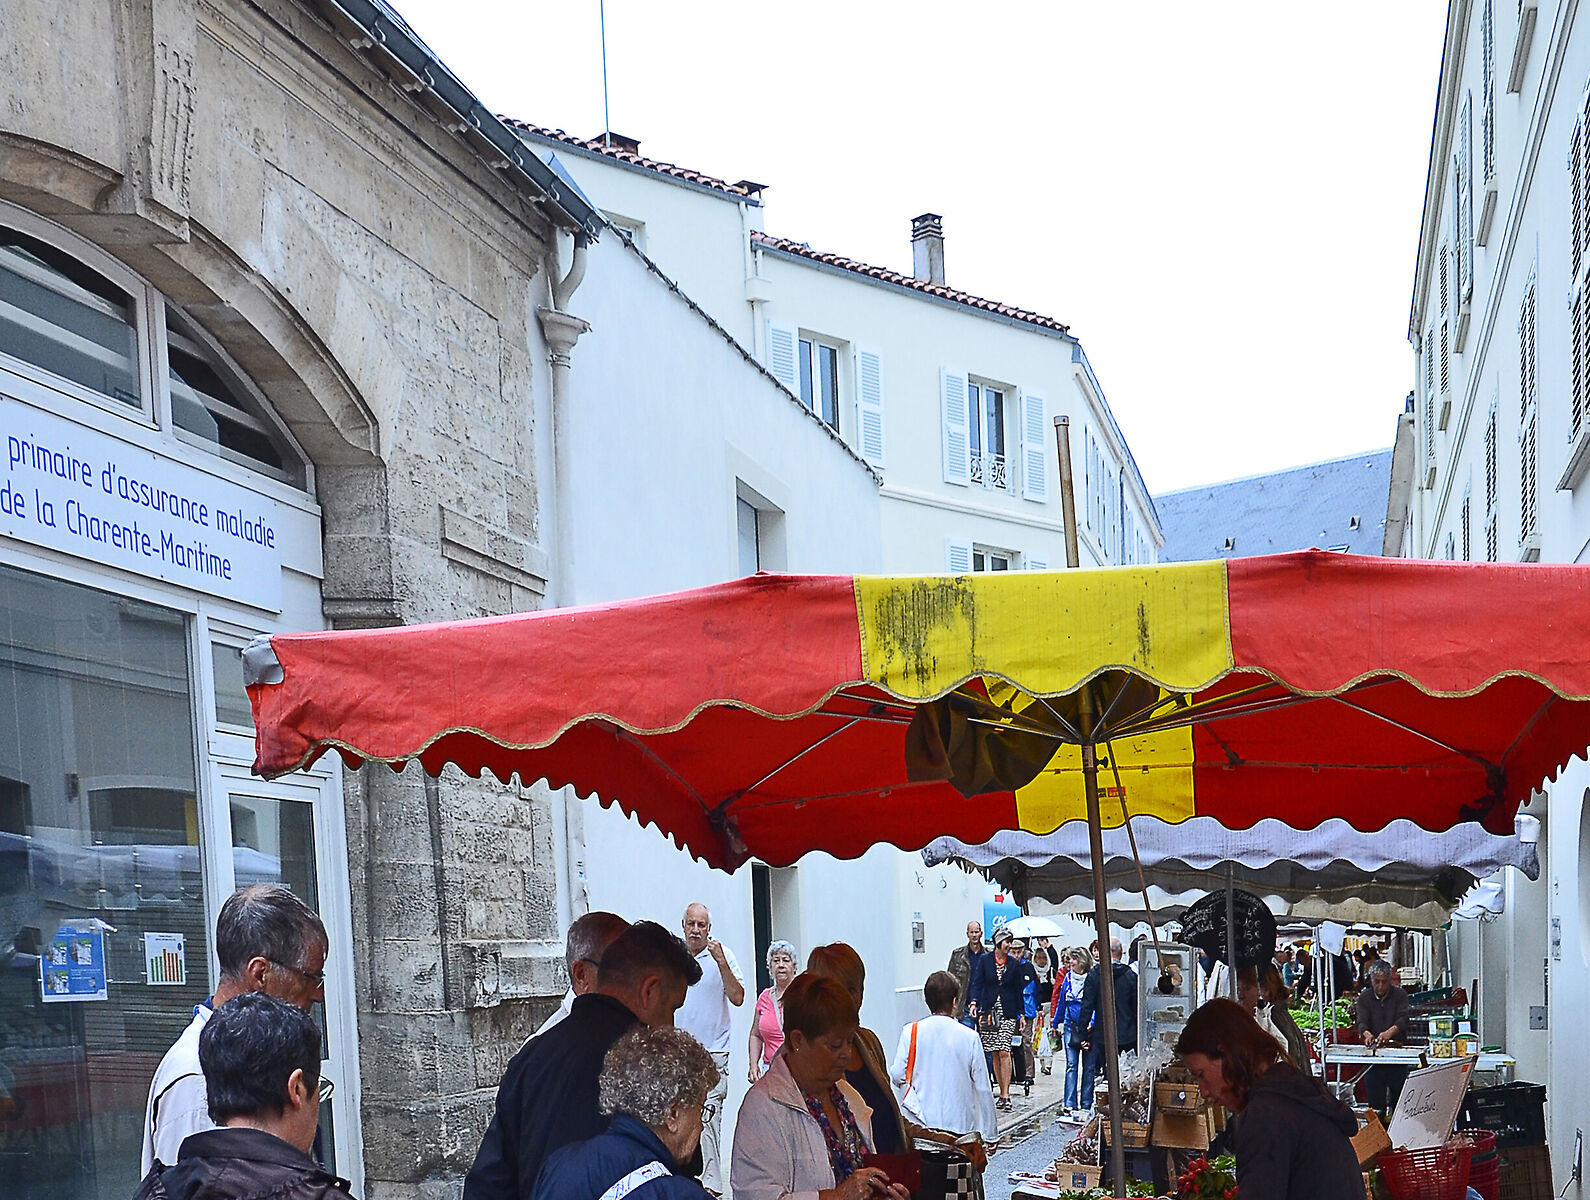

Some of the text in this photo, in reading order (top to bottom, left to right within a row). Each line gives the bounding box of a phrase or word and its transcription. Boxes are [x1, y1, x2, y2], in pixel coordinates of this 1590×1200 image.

[1, 480, 232, 580] de la Charente-Maritime
[8, 433, 275, 549] primaire d'assurance maladie
